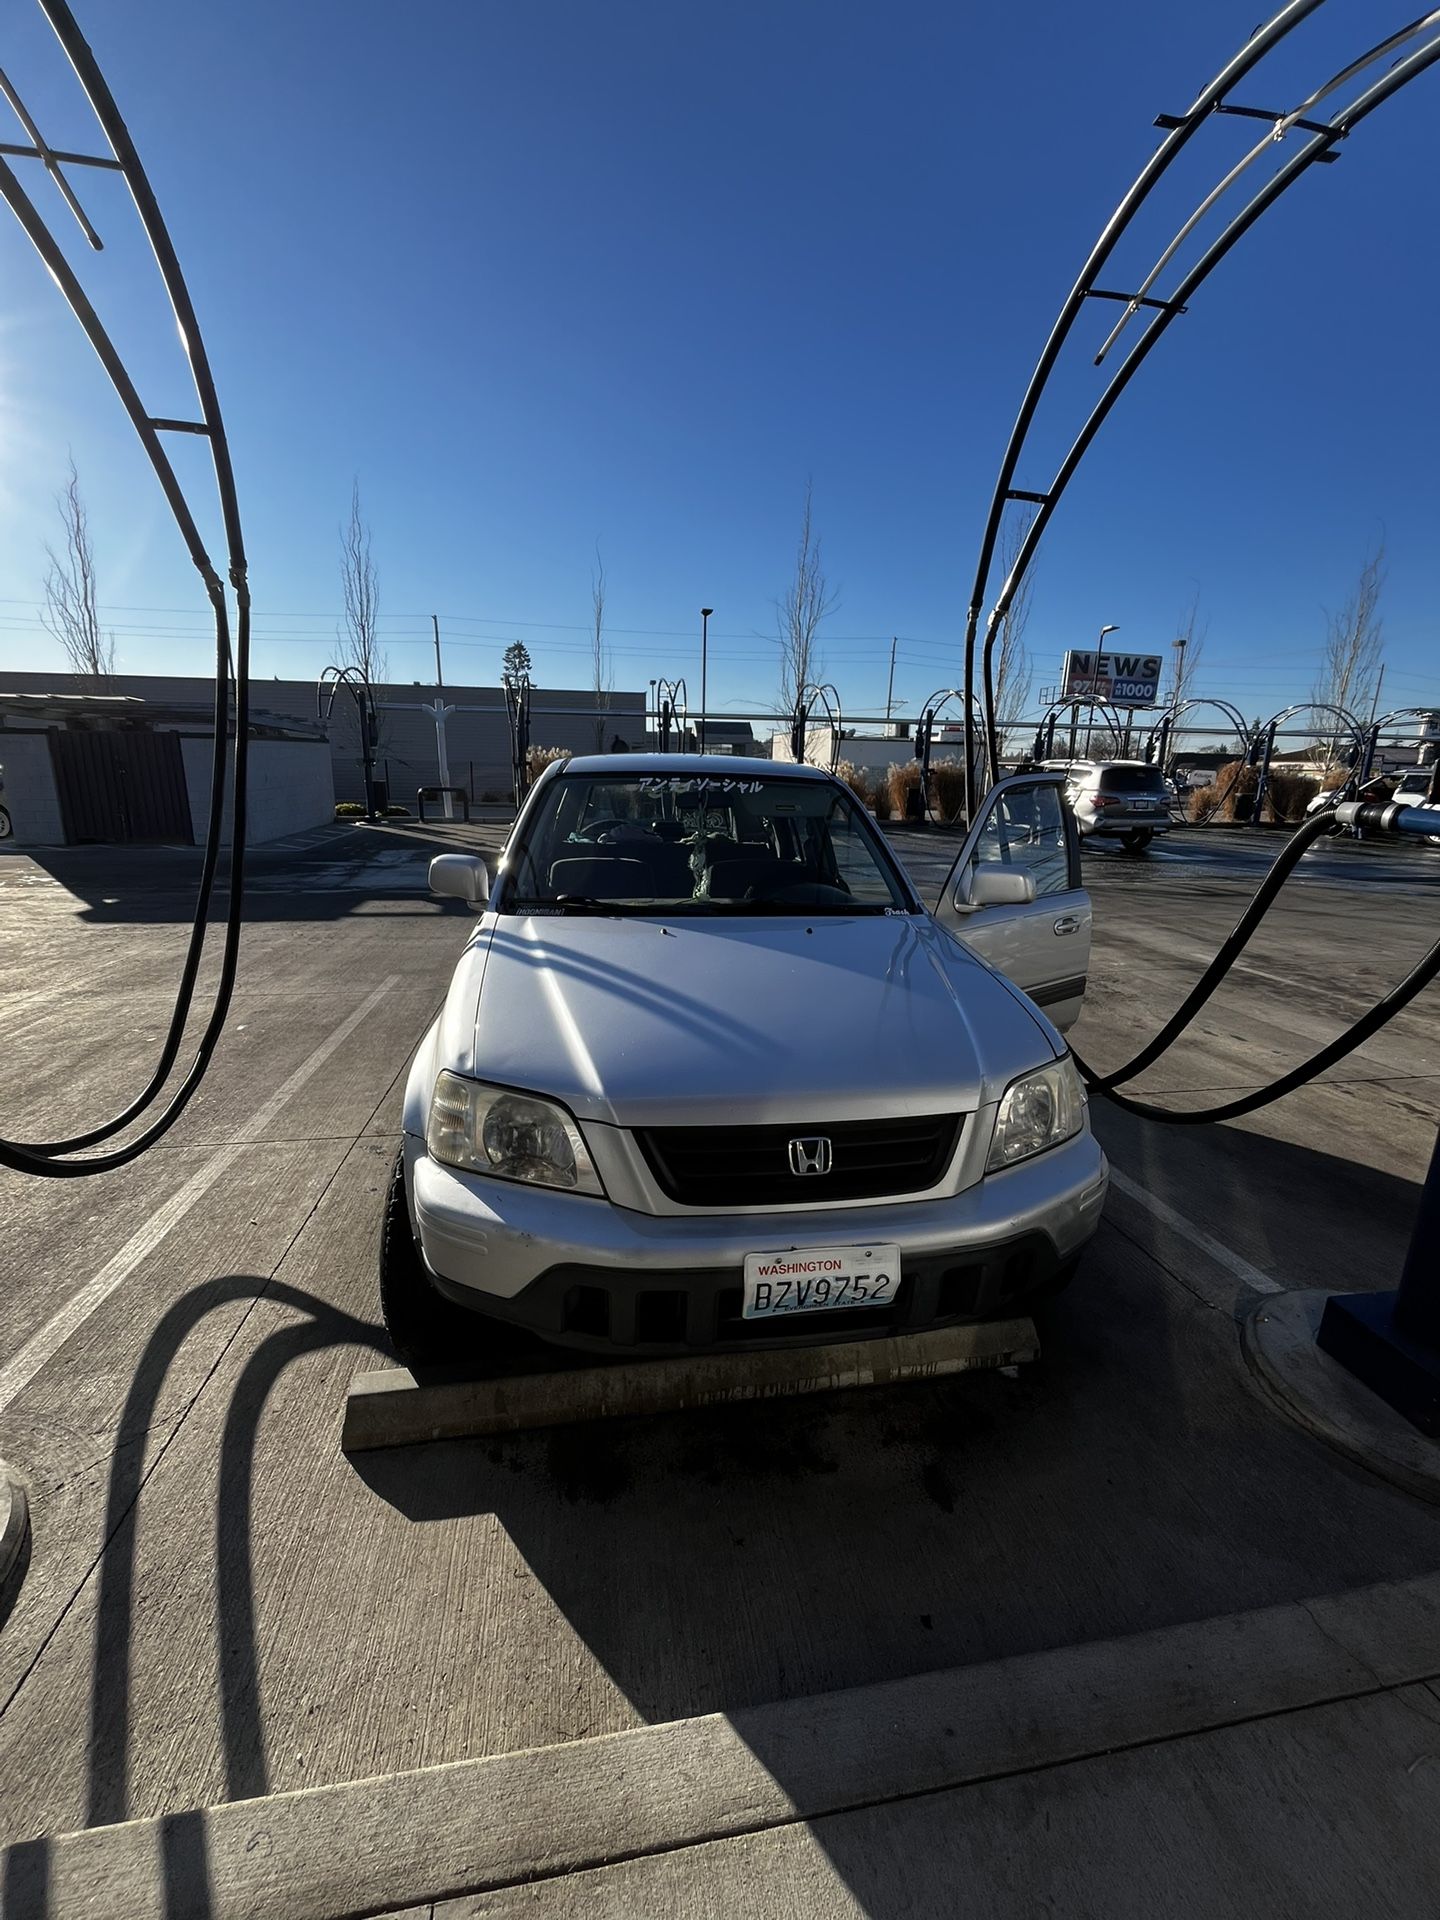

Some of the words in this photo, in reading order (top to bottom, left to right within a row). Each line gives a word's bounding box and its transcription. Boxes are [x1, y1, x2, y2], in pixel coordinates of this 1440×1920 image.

[1071, 654, 1157, 678] NEWS
[1123, 683, 1153, 697] 1000
[758, 1260, 842, 1276] WASHINGTON
[754, 1274, 890, 1311] BZV9752
[784, 1302, 829, 1312] EVERGREEN
